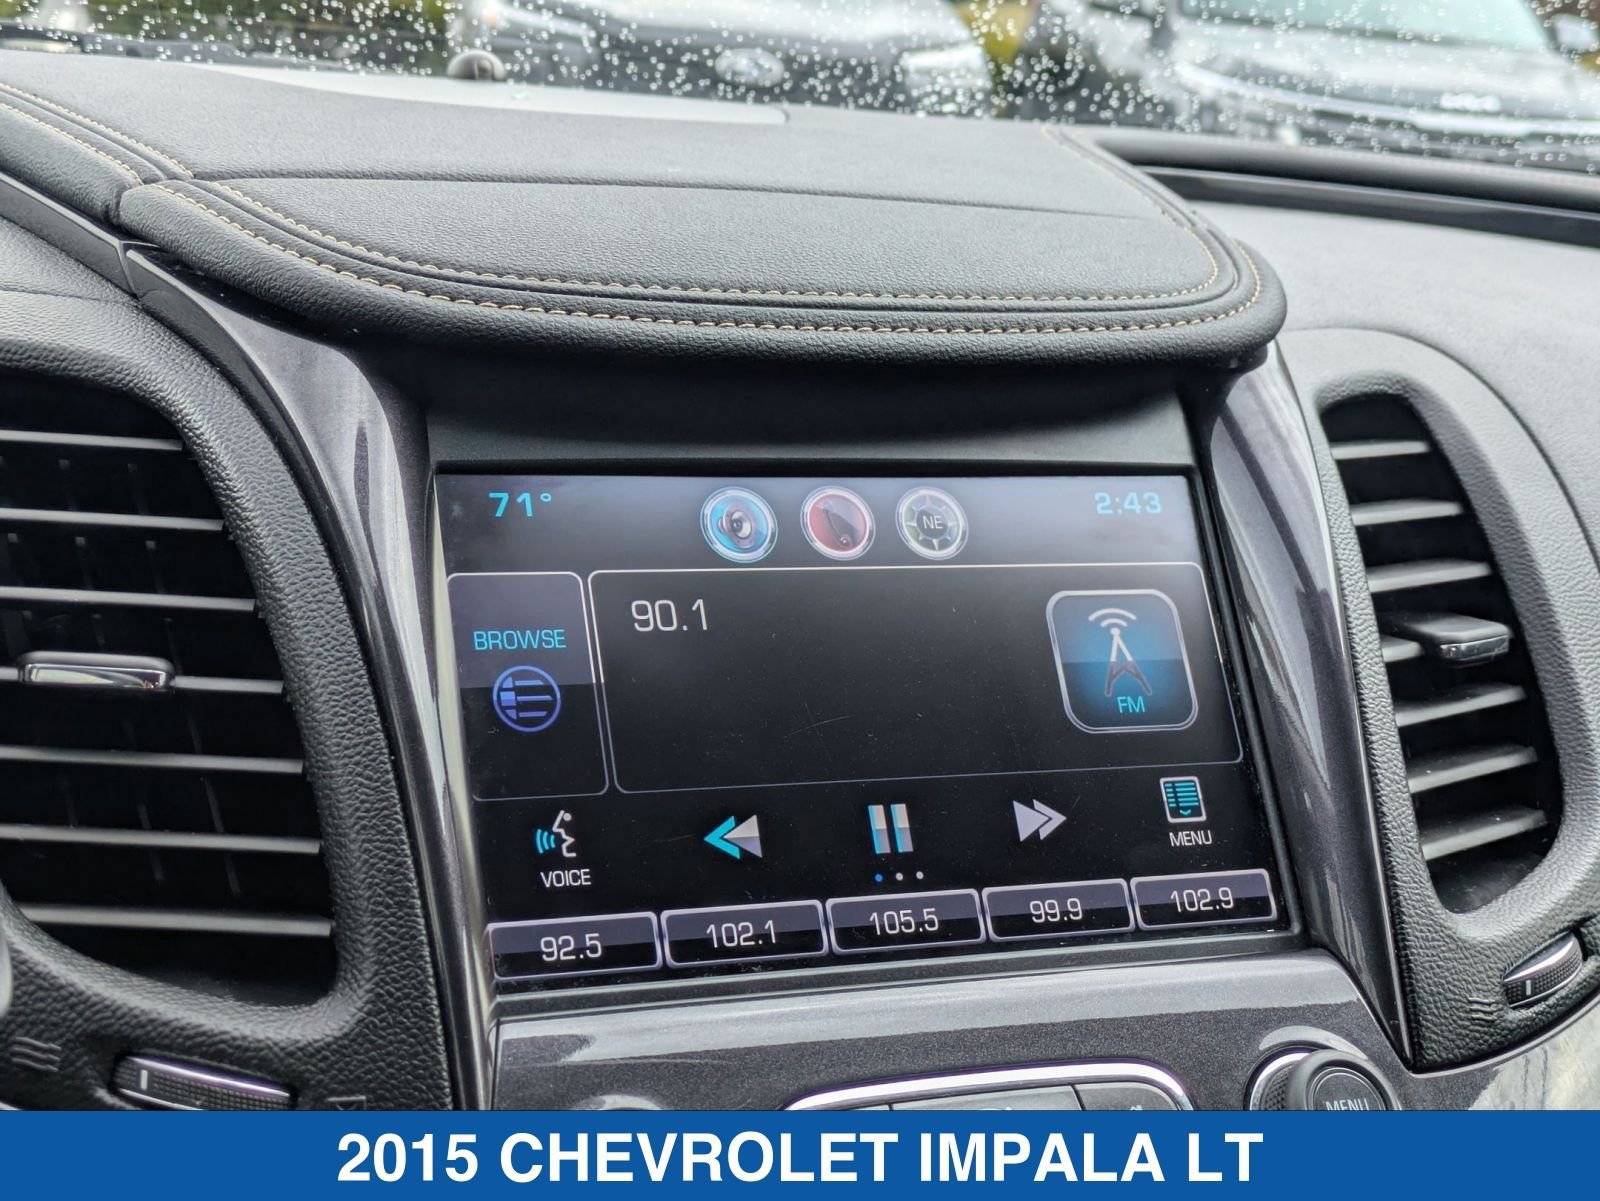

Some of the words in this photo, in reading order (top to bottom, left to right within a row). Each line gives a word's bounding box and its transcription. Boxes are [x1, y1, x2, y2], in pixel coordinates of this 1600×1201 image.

[1094, 492, 1162, 515] 2:43
[922, 514, 943, 530] NE
[631, 599, 709, 632] 90.1
[473, 628, 567, 651] BROWSE
[1117, 695, 1146, 715] FM
[1169, 829, 1213, 848] MENU
[540, 868, 592, 888] VOICE
[1029, 897, 1083, 924] 99.9
[1170, 886, 1235, 913] 102.9
[706, 919, 777, 949] 102.1
[869, 907, 939, 936] 105.5
[540, 933, 601, 962] 92.5
